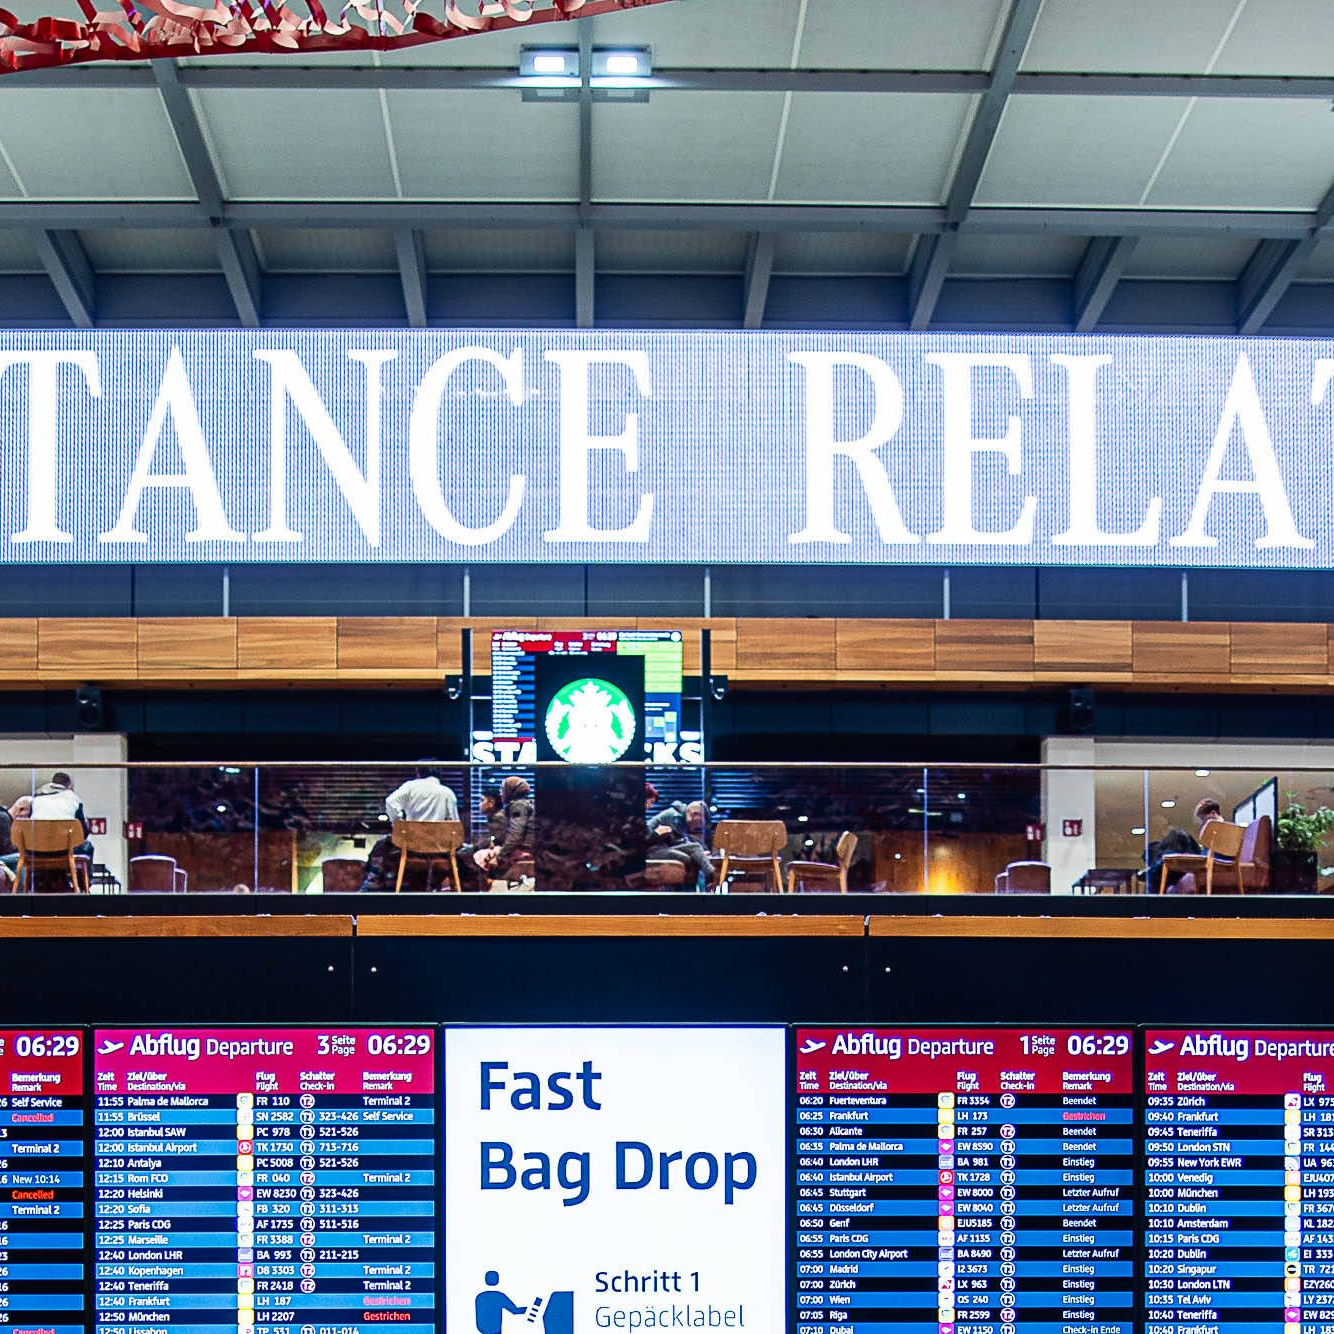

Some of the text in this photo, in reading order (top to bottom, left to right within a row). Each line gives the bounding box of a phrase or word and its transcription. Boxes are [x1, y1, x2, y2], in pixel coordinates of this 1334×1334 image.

[17, 1036, 79, 1056] 06:29
[130, 1034, 293, 1060] Abflug Departure
[318, 1036, 329, 1054] 3
[332, 1035, 355, 1046] Seite
[368, 1035, 430, 1054] 06:29
[832, 1033, 993, 1059] Abflug Departure
[1020, 1036, 1028, 1054] 1
[1032, 1036, 1055, 1047] Seite
[1068, 1036, 1128, 1055] 06:29
[1180, 1034, 1248, 1061] Abflug
[332, 1045, 355, 1056] Page
[1032, 1044, 1054, 1056] Page
[98, 1082, 117, 1090] Time
[256, 1080, 278, 1092] Flight
[363, 1082, 392, 1090] Remark
[481, 1060, 602, 1111] Fast
[1148, 1158, 1173, 1167] 09:55
[1178, 1158, 1196, 1167] New
[1195, 1158, 1219, 1167] York
[1221, 1158, 1241, 1167] EWR
[1304, 1159, 1316, 1167] UA
[481, 1141, 757, 1207] Bag Drop
[12, 1190, 54, 1199] Cancelled
[595, 1271, 700, 1293] Schritt 1
[800, 1296, 823, 1304] 07:00
[830, 1296, 850, 1304] Wien
[1063, 1295, 1094, 1305] Einstieg
[595, 1305, 745, 1332] Gepäcklabel
